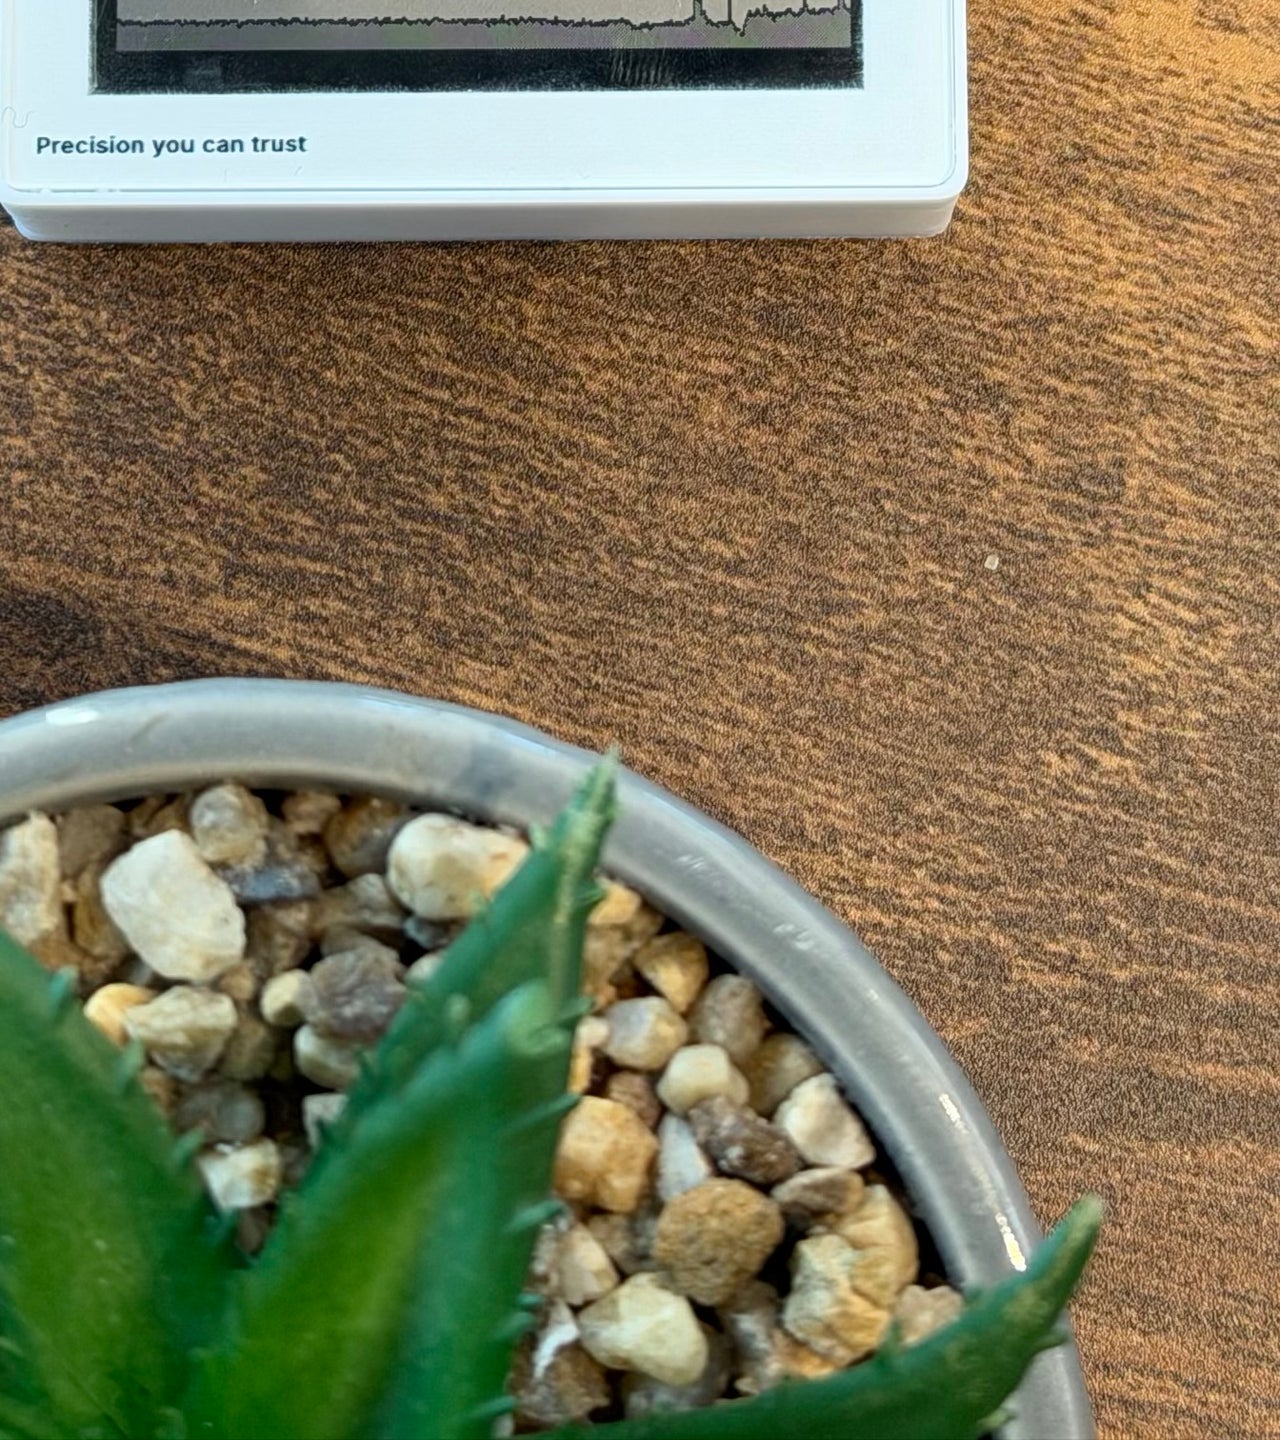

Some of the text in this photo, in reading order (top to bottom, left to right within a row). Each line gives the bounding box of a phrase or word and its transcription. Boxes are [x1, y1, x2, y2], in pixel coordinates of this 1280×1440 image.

[36, 136, 307, 158] Precision you can trust
